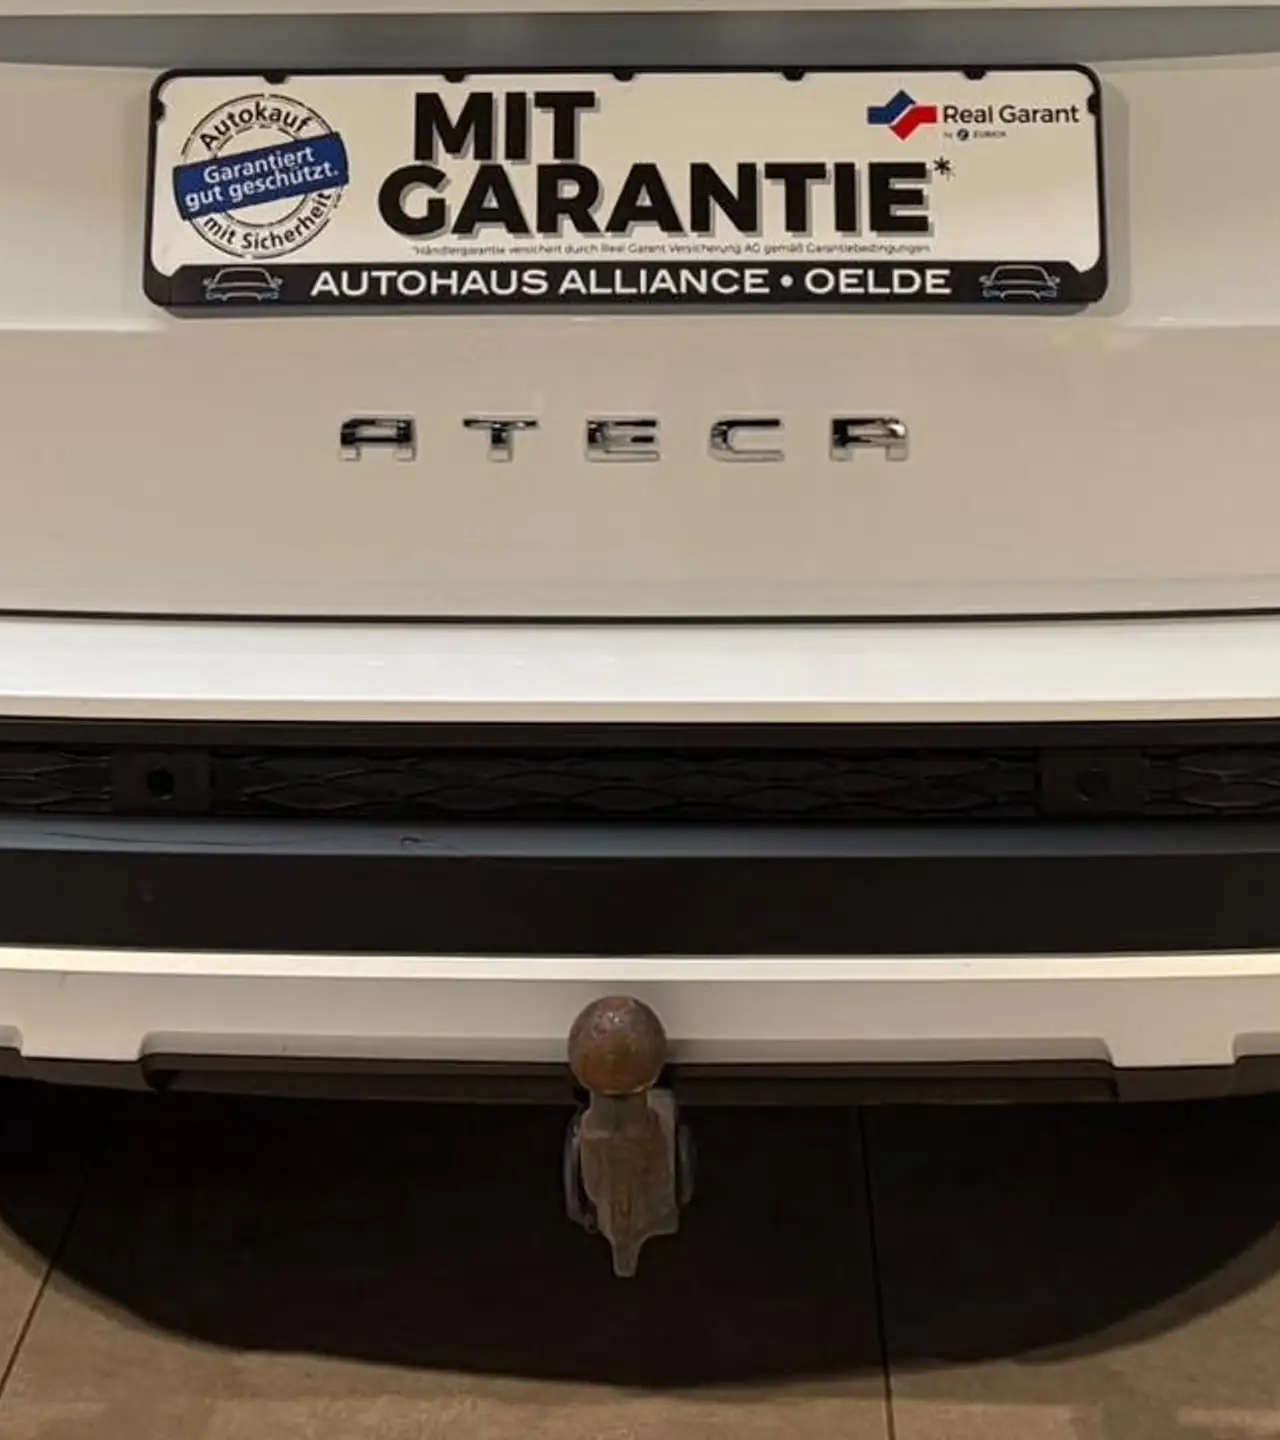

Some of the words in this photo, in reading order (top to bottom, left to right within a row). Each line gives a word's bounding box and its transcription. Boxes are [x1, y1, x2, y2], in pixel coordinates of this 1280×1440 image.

[199, 101, 313, 151] Autokauf
[413, 91, 596, 162] MIT
[942, 105, 993, 124] Real
[998, 105, 1080, 124] Garant
[184, 185, 224, 211] gut
[228, 160, 339, 203] geschützt.
[203, 145, 316, 184] Garantiert
[203, 216, 238, 245] mit
[239, 190, 332, 251] Sicherheit
[311, 268, 549, 296] AUTOHAUS
[558, 268, 770, 296] ALLIANCE
[804, 267, 952, 295] OELDE
[338, 417, 908, 461] ATECA
